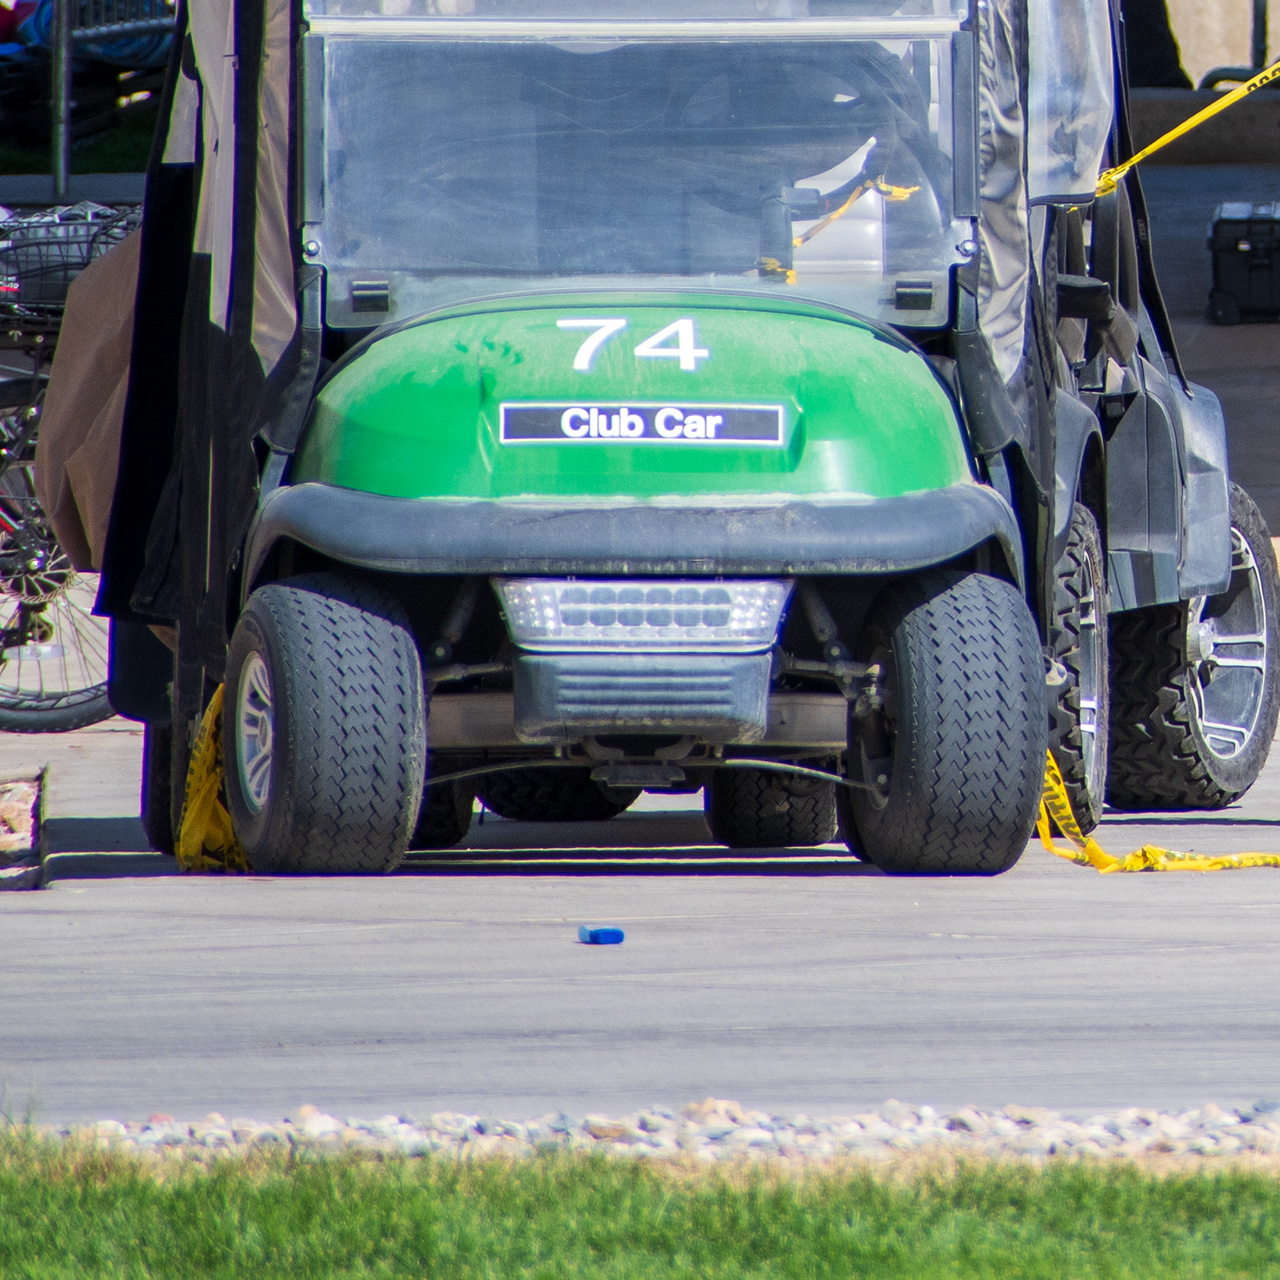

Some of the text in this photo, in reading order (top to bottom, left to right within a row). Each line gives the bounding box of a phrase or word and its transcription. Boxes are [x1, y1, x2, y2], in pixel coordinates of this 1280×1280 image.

[556, 318, 709, 371] 74
[560, 406, 723, 439] Club Car
